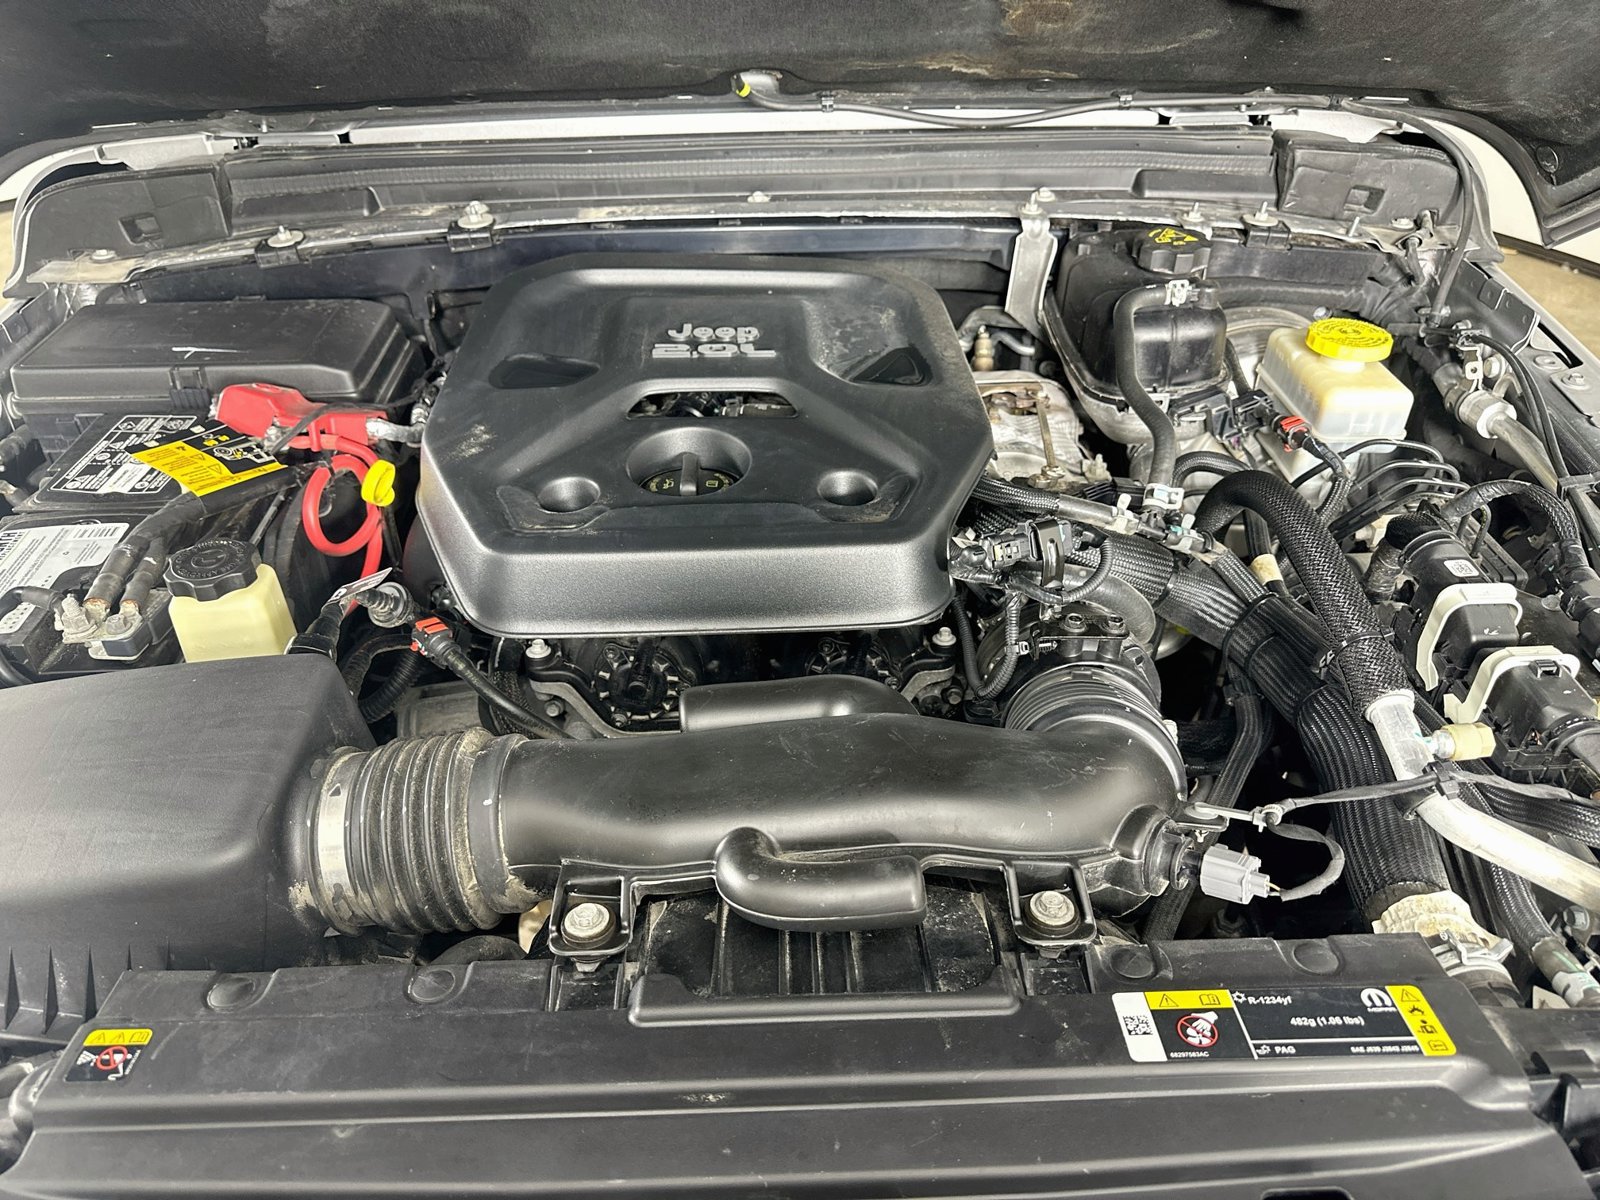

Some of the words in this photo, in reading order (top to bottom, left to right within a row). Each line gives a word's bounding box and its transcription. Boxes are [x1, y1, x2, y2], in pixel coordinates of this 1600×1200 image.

[668, 323, 759, 343] Jeep
[652, 343, 776, 358] 2.0L
[1290, 1016, 1317, 1027] 482g
[1342, 1015, 1365, 1026] lbs)
[1274, 1045, 1296, 1054] PAG
